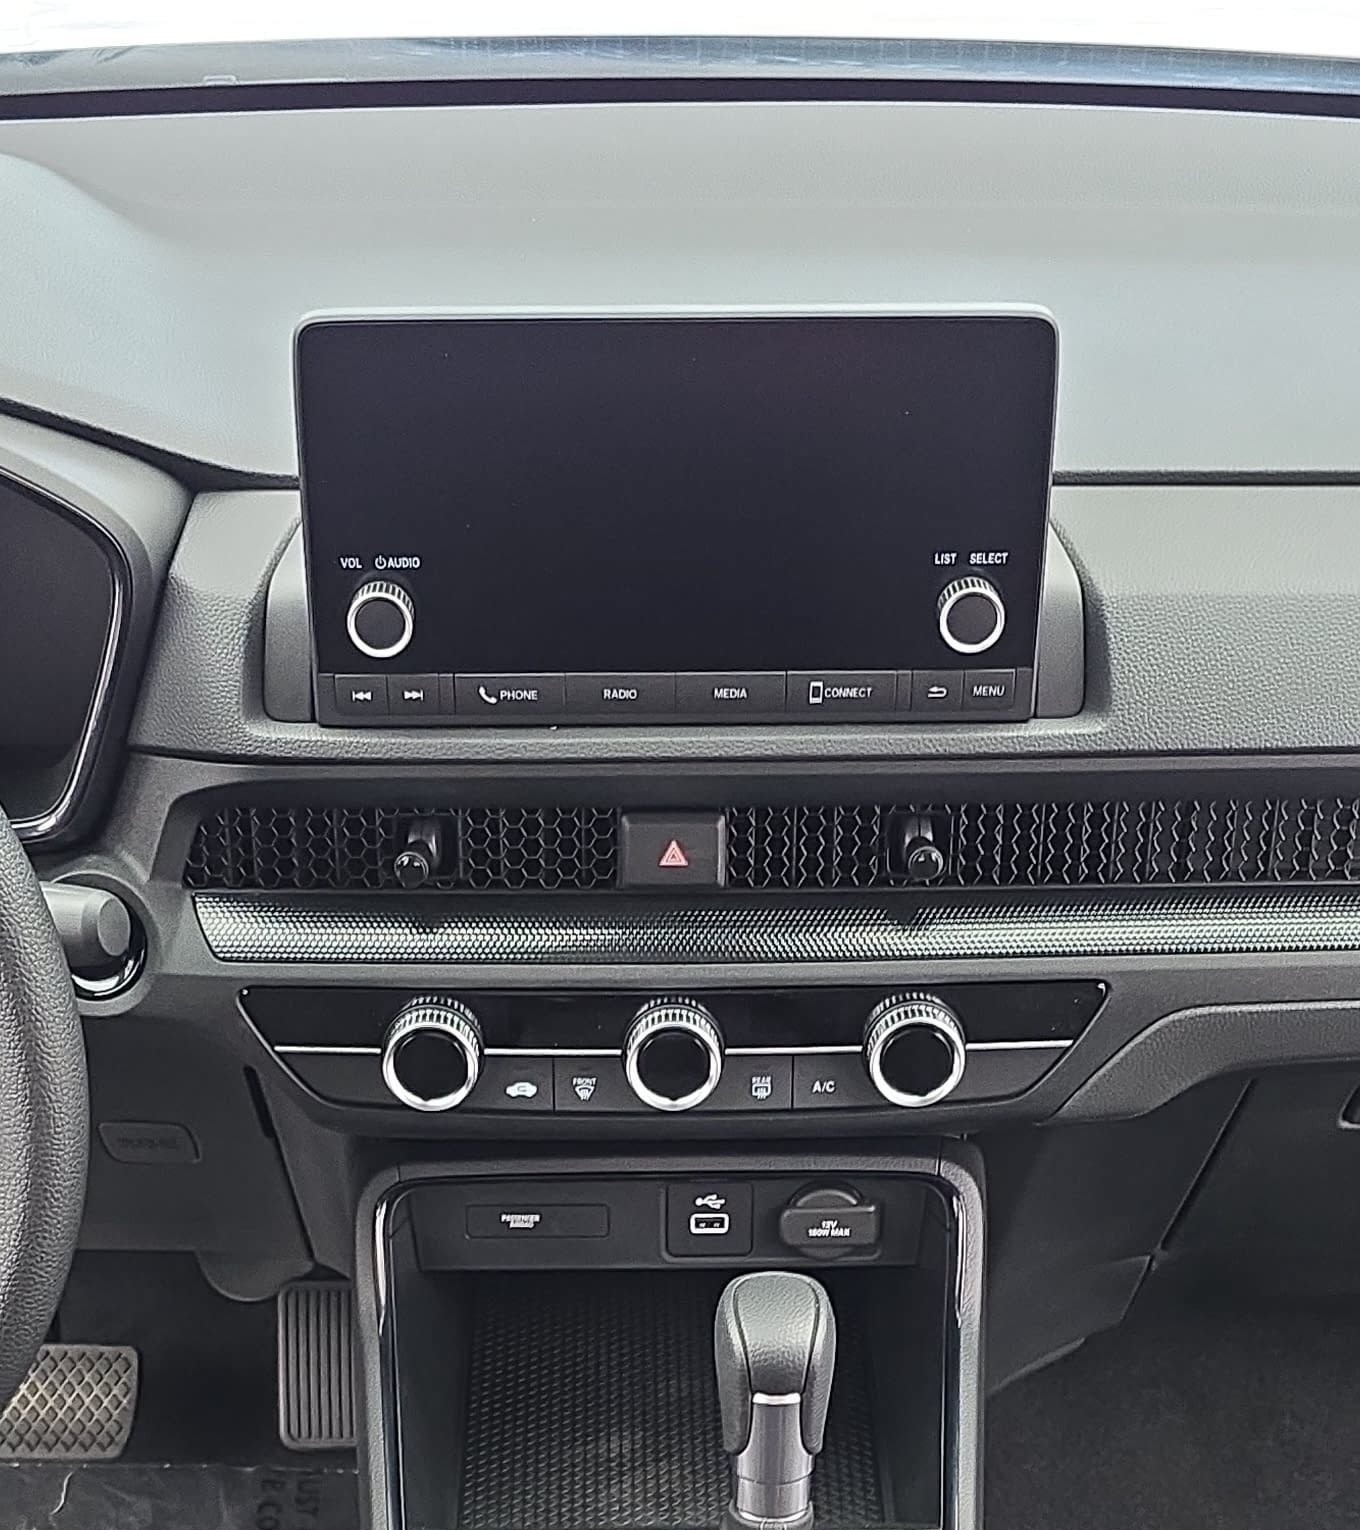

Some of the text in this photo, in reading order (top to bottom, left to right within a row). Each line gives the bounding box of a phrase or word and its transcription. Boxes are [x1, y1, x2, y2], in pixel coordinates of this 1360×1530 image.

[340, 557, 362, 569] VOL
[387, 556, 421, 569] AUDIO
[934, 552, 957, 565] LIST
[969, 552, 1009, 565] SELECT
[499, 688, 538, 702] PHONE
[602, 687, 638, 701] RADIO
[713, 687, 748, 701] MEDIA
[824, 686, 873, 699] CONNECT
[973, 684, 1005, 698] MENU
[812, 1079, 835, 1093] A/C
